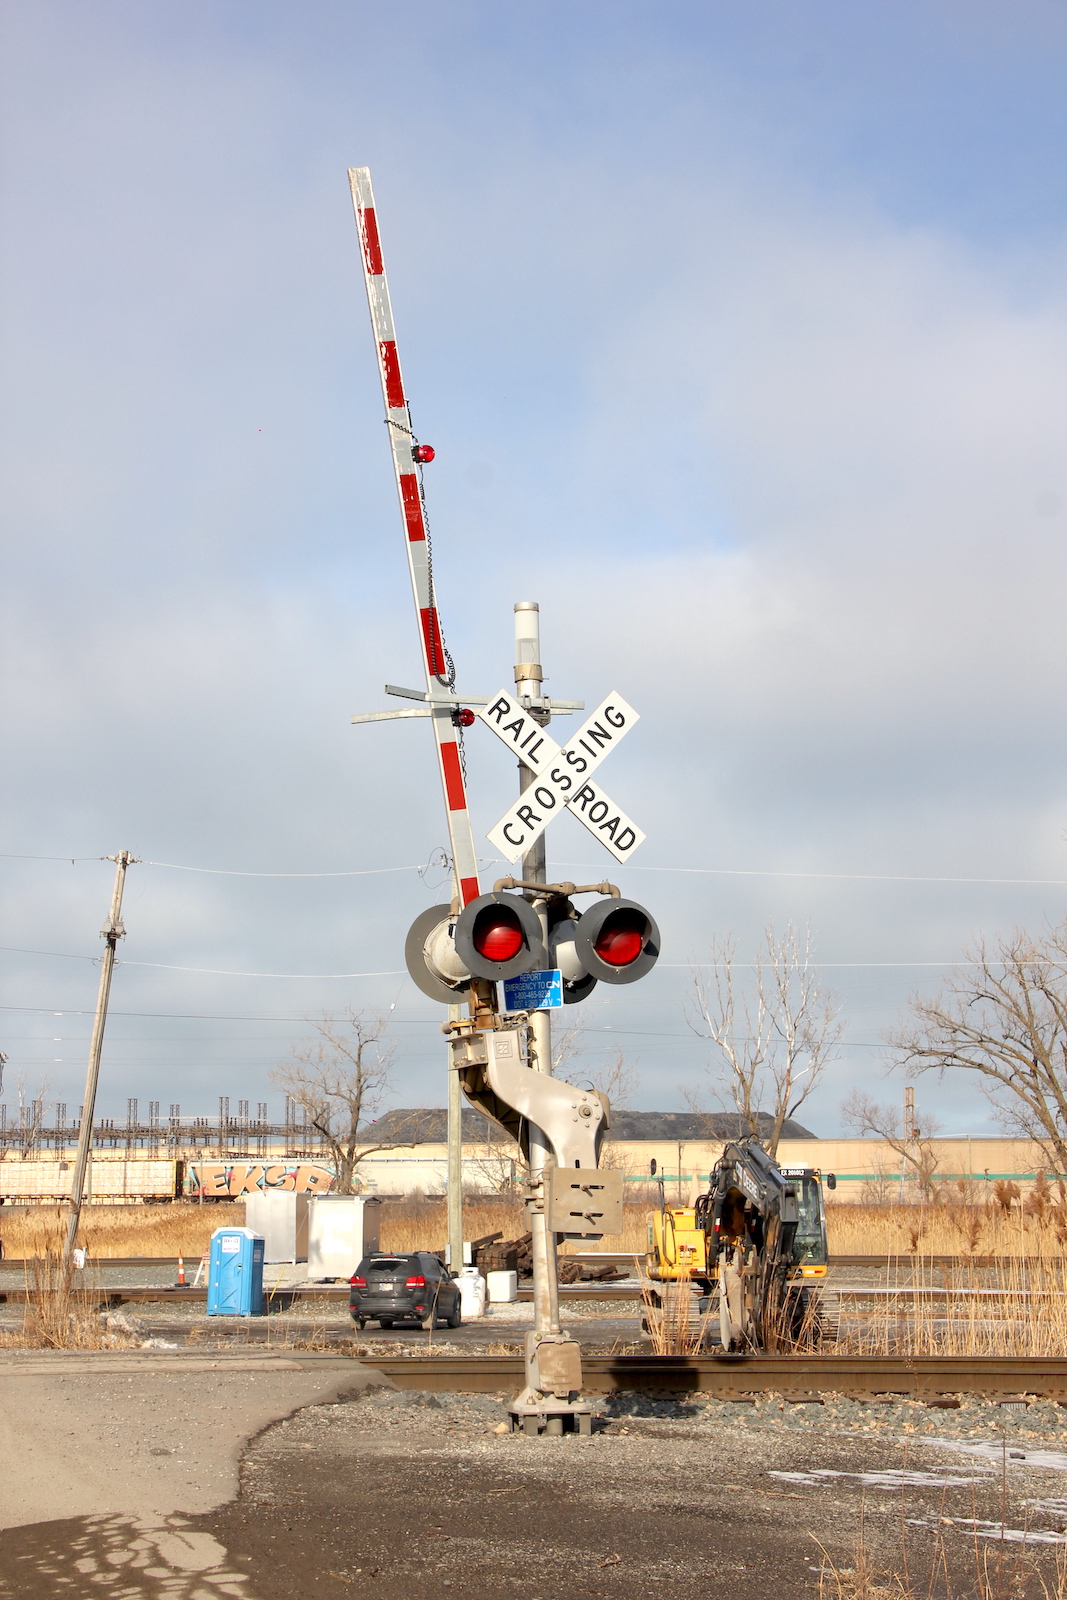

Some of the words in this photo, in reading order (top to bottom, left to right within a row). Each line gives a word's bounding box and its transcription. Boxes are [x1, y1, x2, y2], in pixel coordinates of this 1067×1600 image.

[487, 697, 545, 765] RAIL
[572, 784, 636, 851] ROAD
[502, 705, 626, 846] CROSSING
[505, 983, 537, 992] EMERGENCY
[537, 981, 545, 990] TO
[546, 981, 560, 989] CN
[520, 973, 542, 982] REPORT
